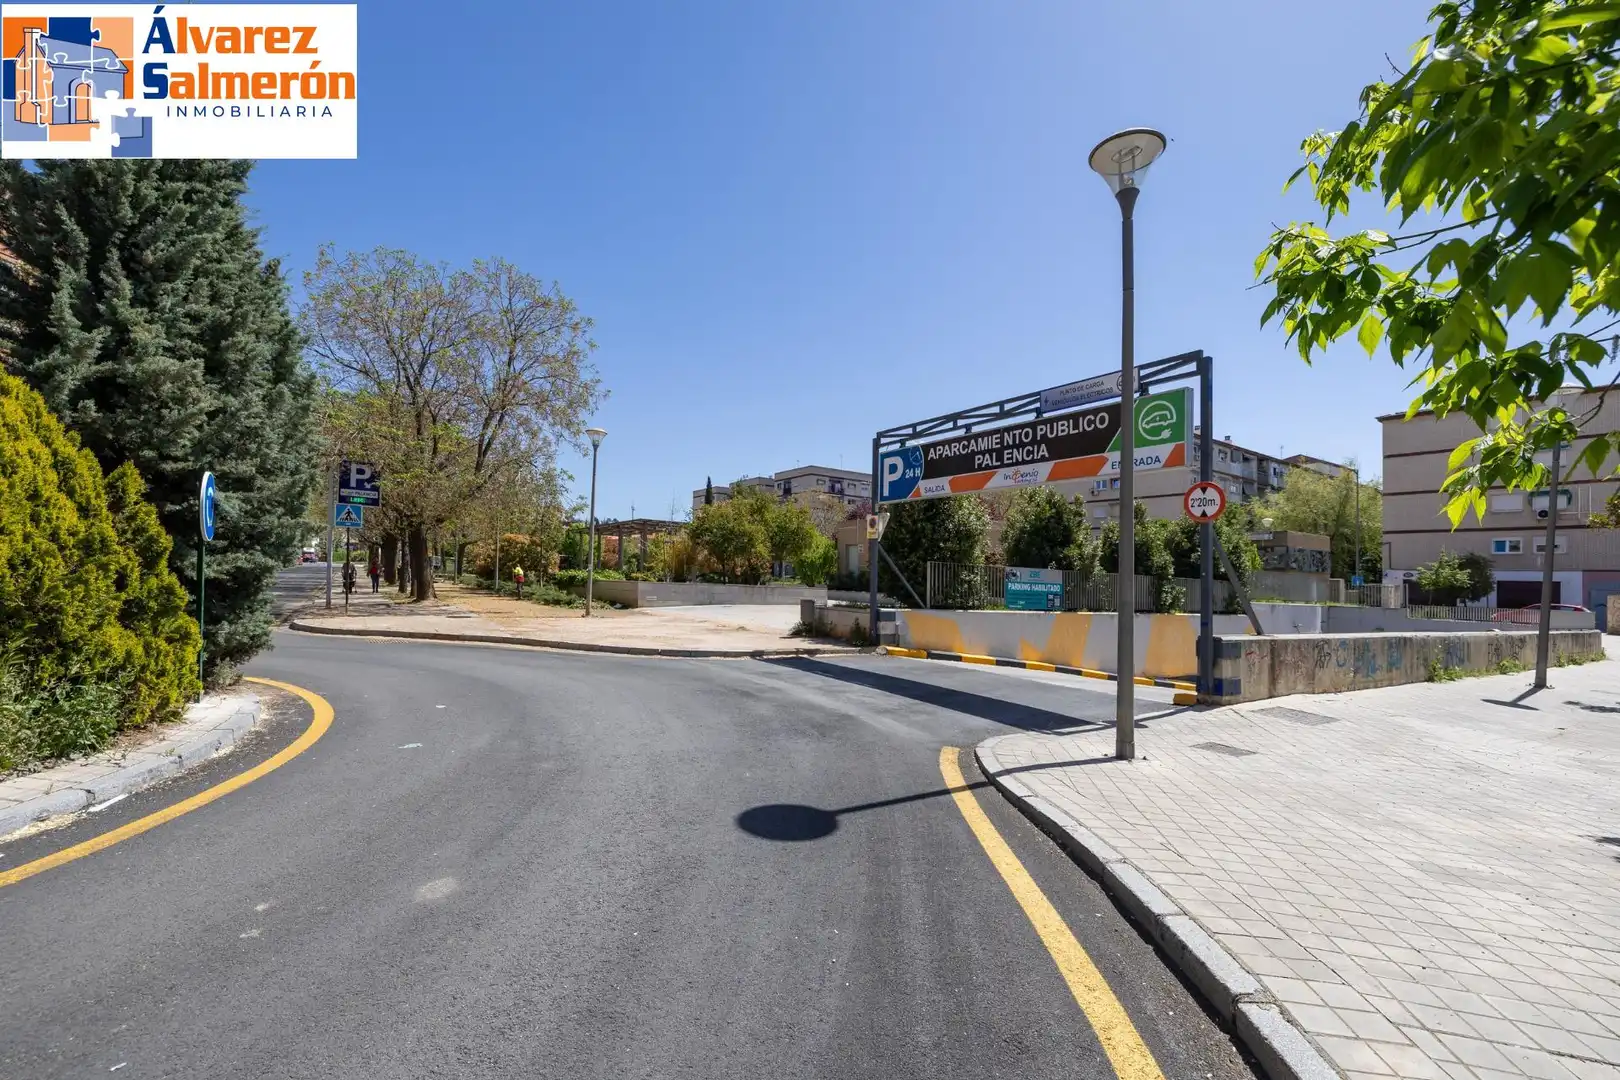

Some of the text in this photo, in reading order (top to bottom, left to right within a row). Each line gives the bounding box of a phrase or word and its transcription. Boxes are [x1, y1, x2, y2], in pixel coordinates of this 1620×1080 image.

[1037, 412, 1110, 441] PUBLICO
[882, 455, 904, 497] P
[904, 467, 921, 478] 24 H
[923, 484, 946, 494] SALIDA
